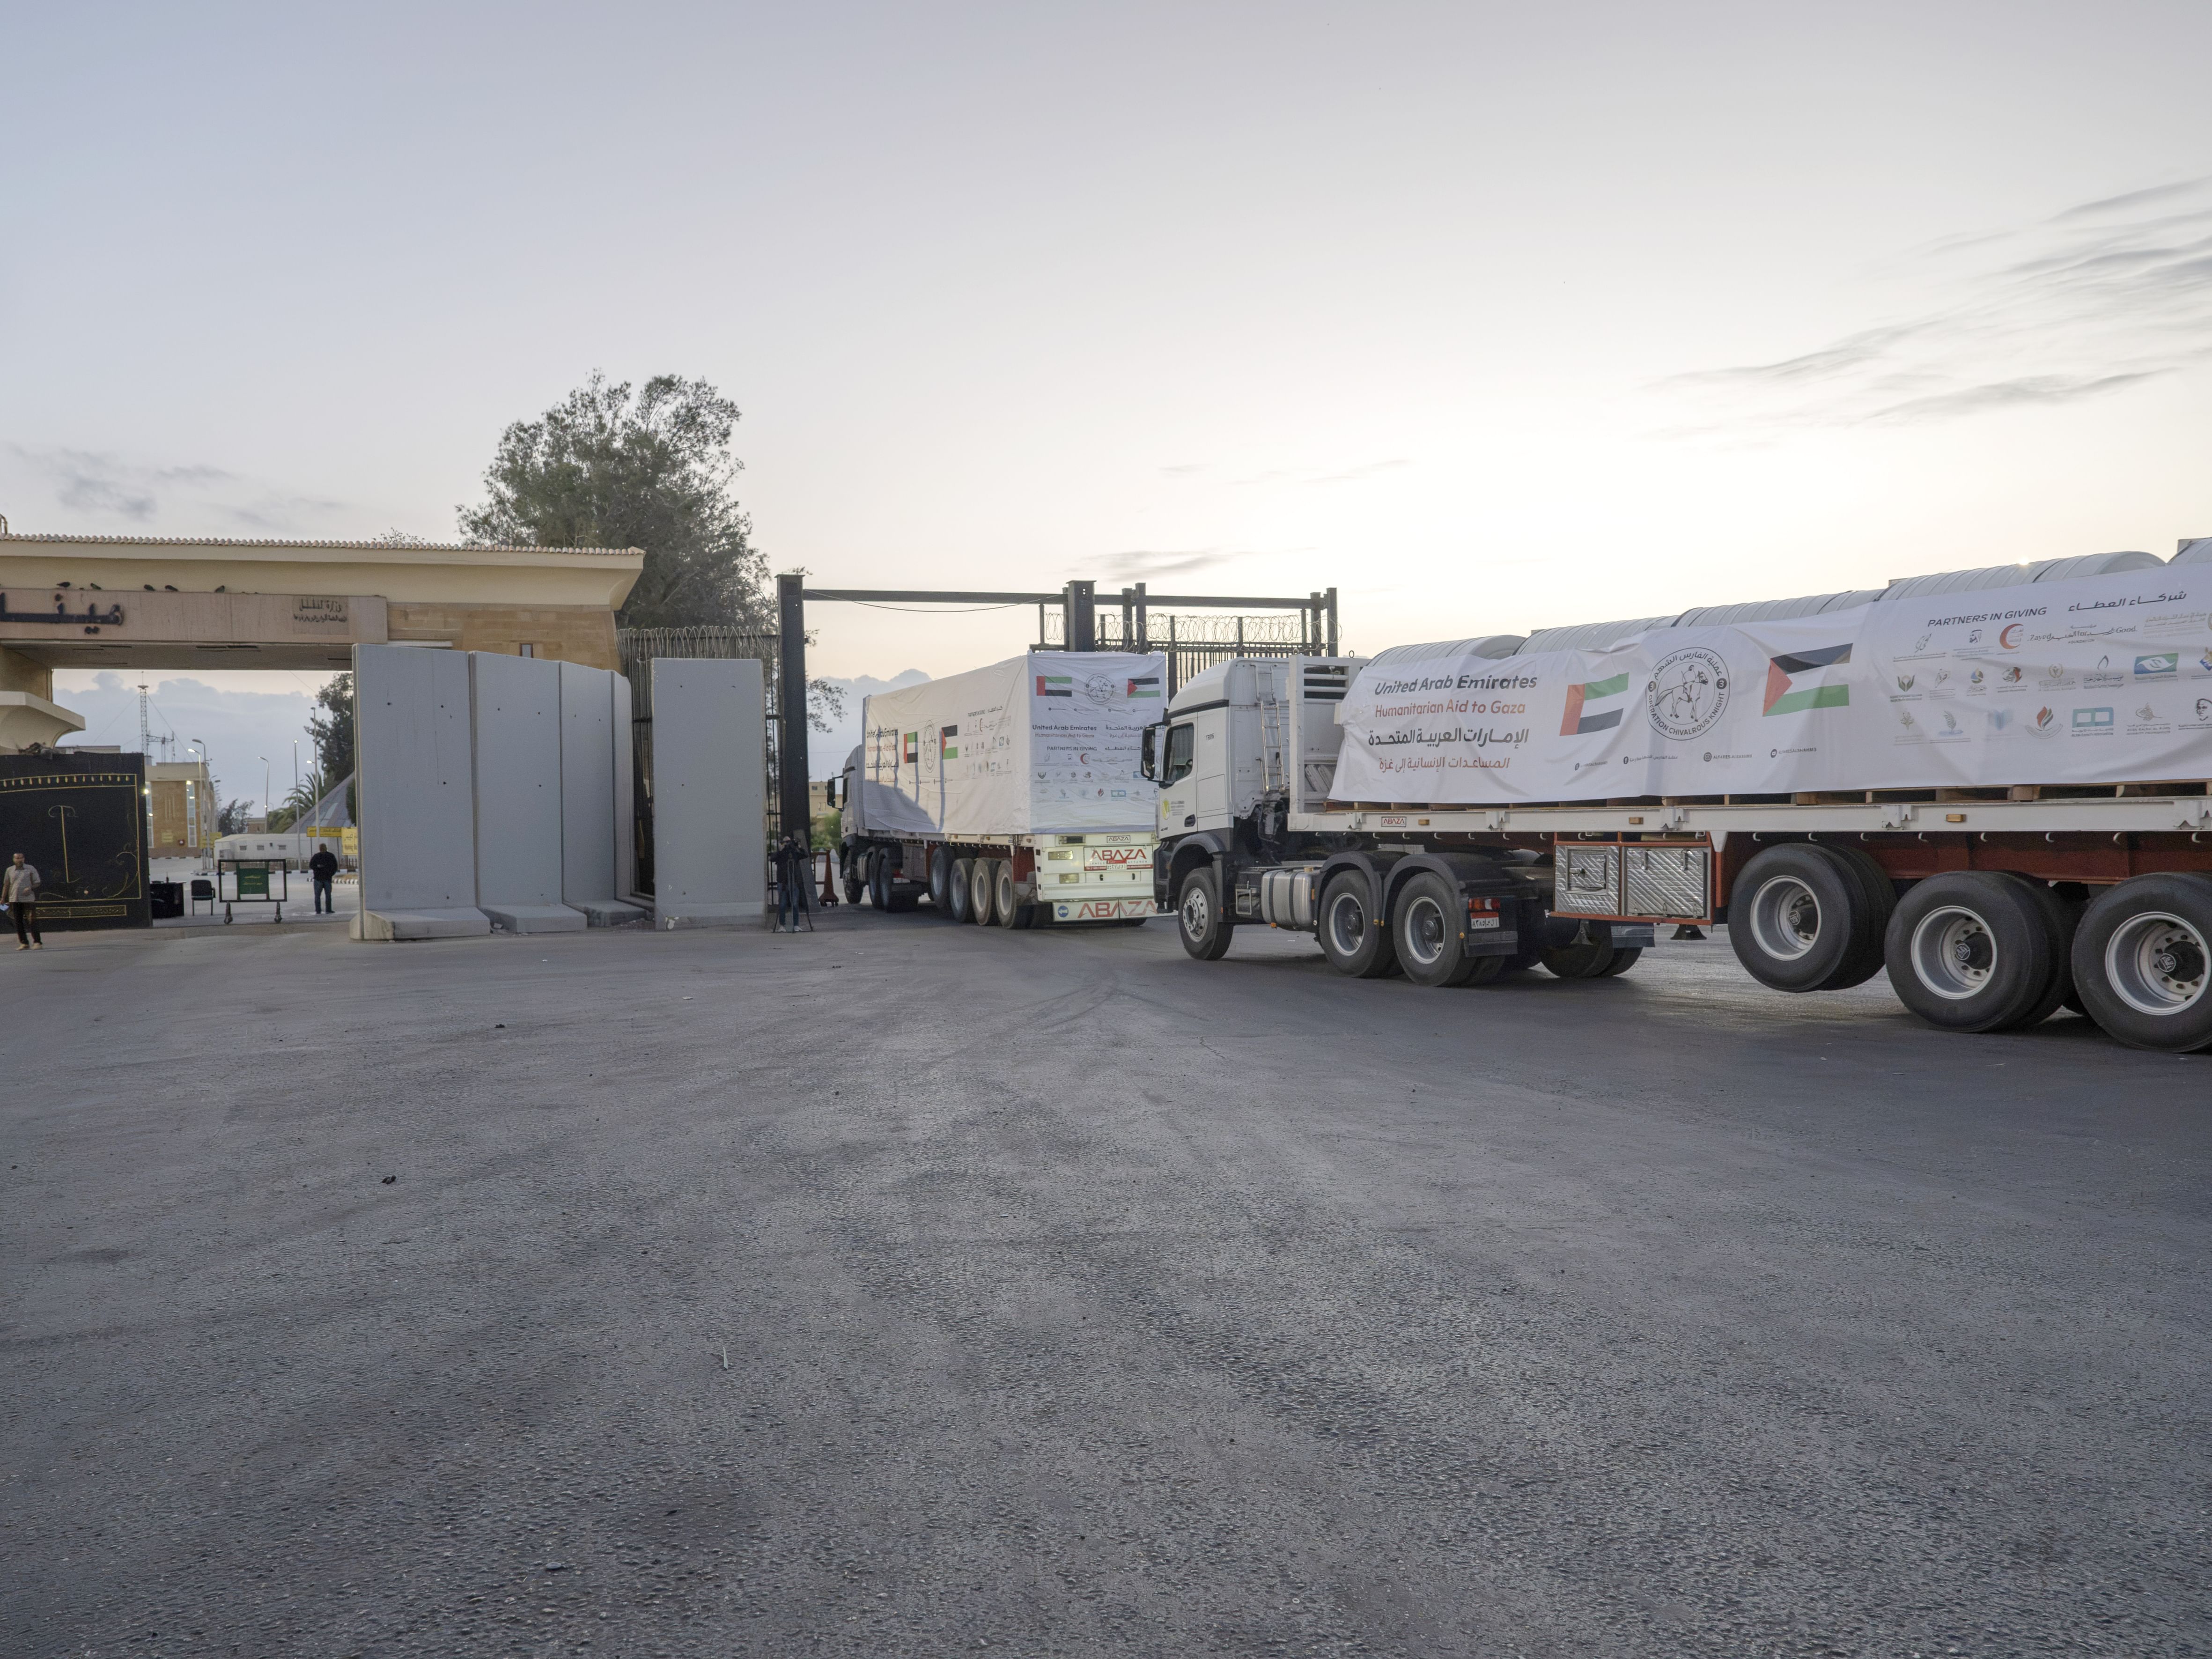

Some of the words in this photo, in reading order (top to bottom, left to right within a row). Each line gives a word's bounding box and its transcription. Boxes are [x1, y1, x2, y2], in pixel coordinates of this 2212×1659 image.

[2068, 598, 2127, 612] العطاء
[2129, 590, 2187, 606] شركاء
[1927, 614, 1988, 627] PARTNERS
[1990, 612, 2002, 621] IN
[2005, 607, 2048, 619] GIVING
[1679, 651, 1708, 661] الفارس
[1654, 655, 1677, 681] الشهم
[1707, 656, 1722, 677] عملية
[1374, 678, 1418, 695] United
[1418, 675, 1453, 692] Arab
[1457, 675, 1538, 689] Emirates
[1375, 701, 1444, 718] Humanitarian
[1446, 699, 1469, 713] Aid
[1472, 701, 1486, 714] to
[1490, 700, 1526, 714] Gaza
[1648, 694, 1669, 731] OPERATION
[1669, 718, 1710, 736] CHIVALROUS
[1709, 692, 1725, 720] KNIGHT
[1368, 729, 1416, 746] المتحدة
[1416, 727, 1461, 748] العربية
[1464, 728, 1529, 749] الإمارات
[1379, 757, 1394, 773] غزة
[1395, 758, 1406, 773] إلى
[1407, 756, 1445, 773] الإنسانية
[1448, 756, 1511, 769] المساعدات
[1089, 848, 1147, 862] ABAZA
[1077, 900, 1159, 918] ABAZA
